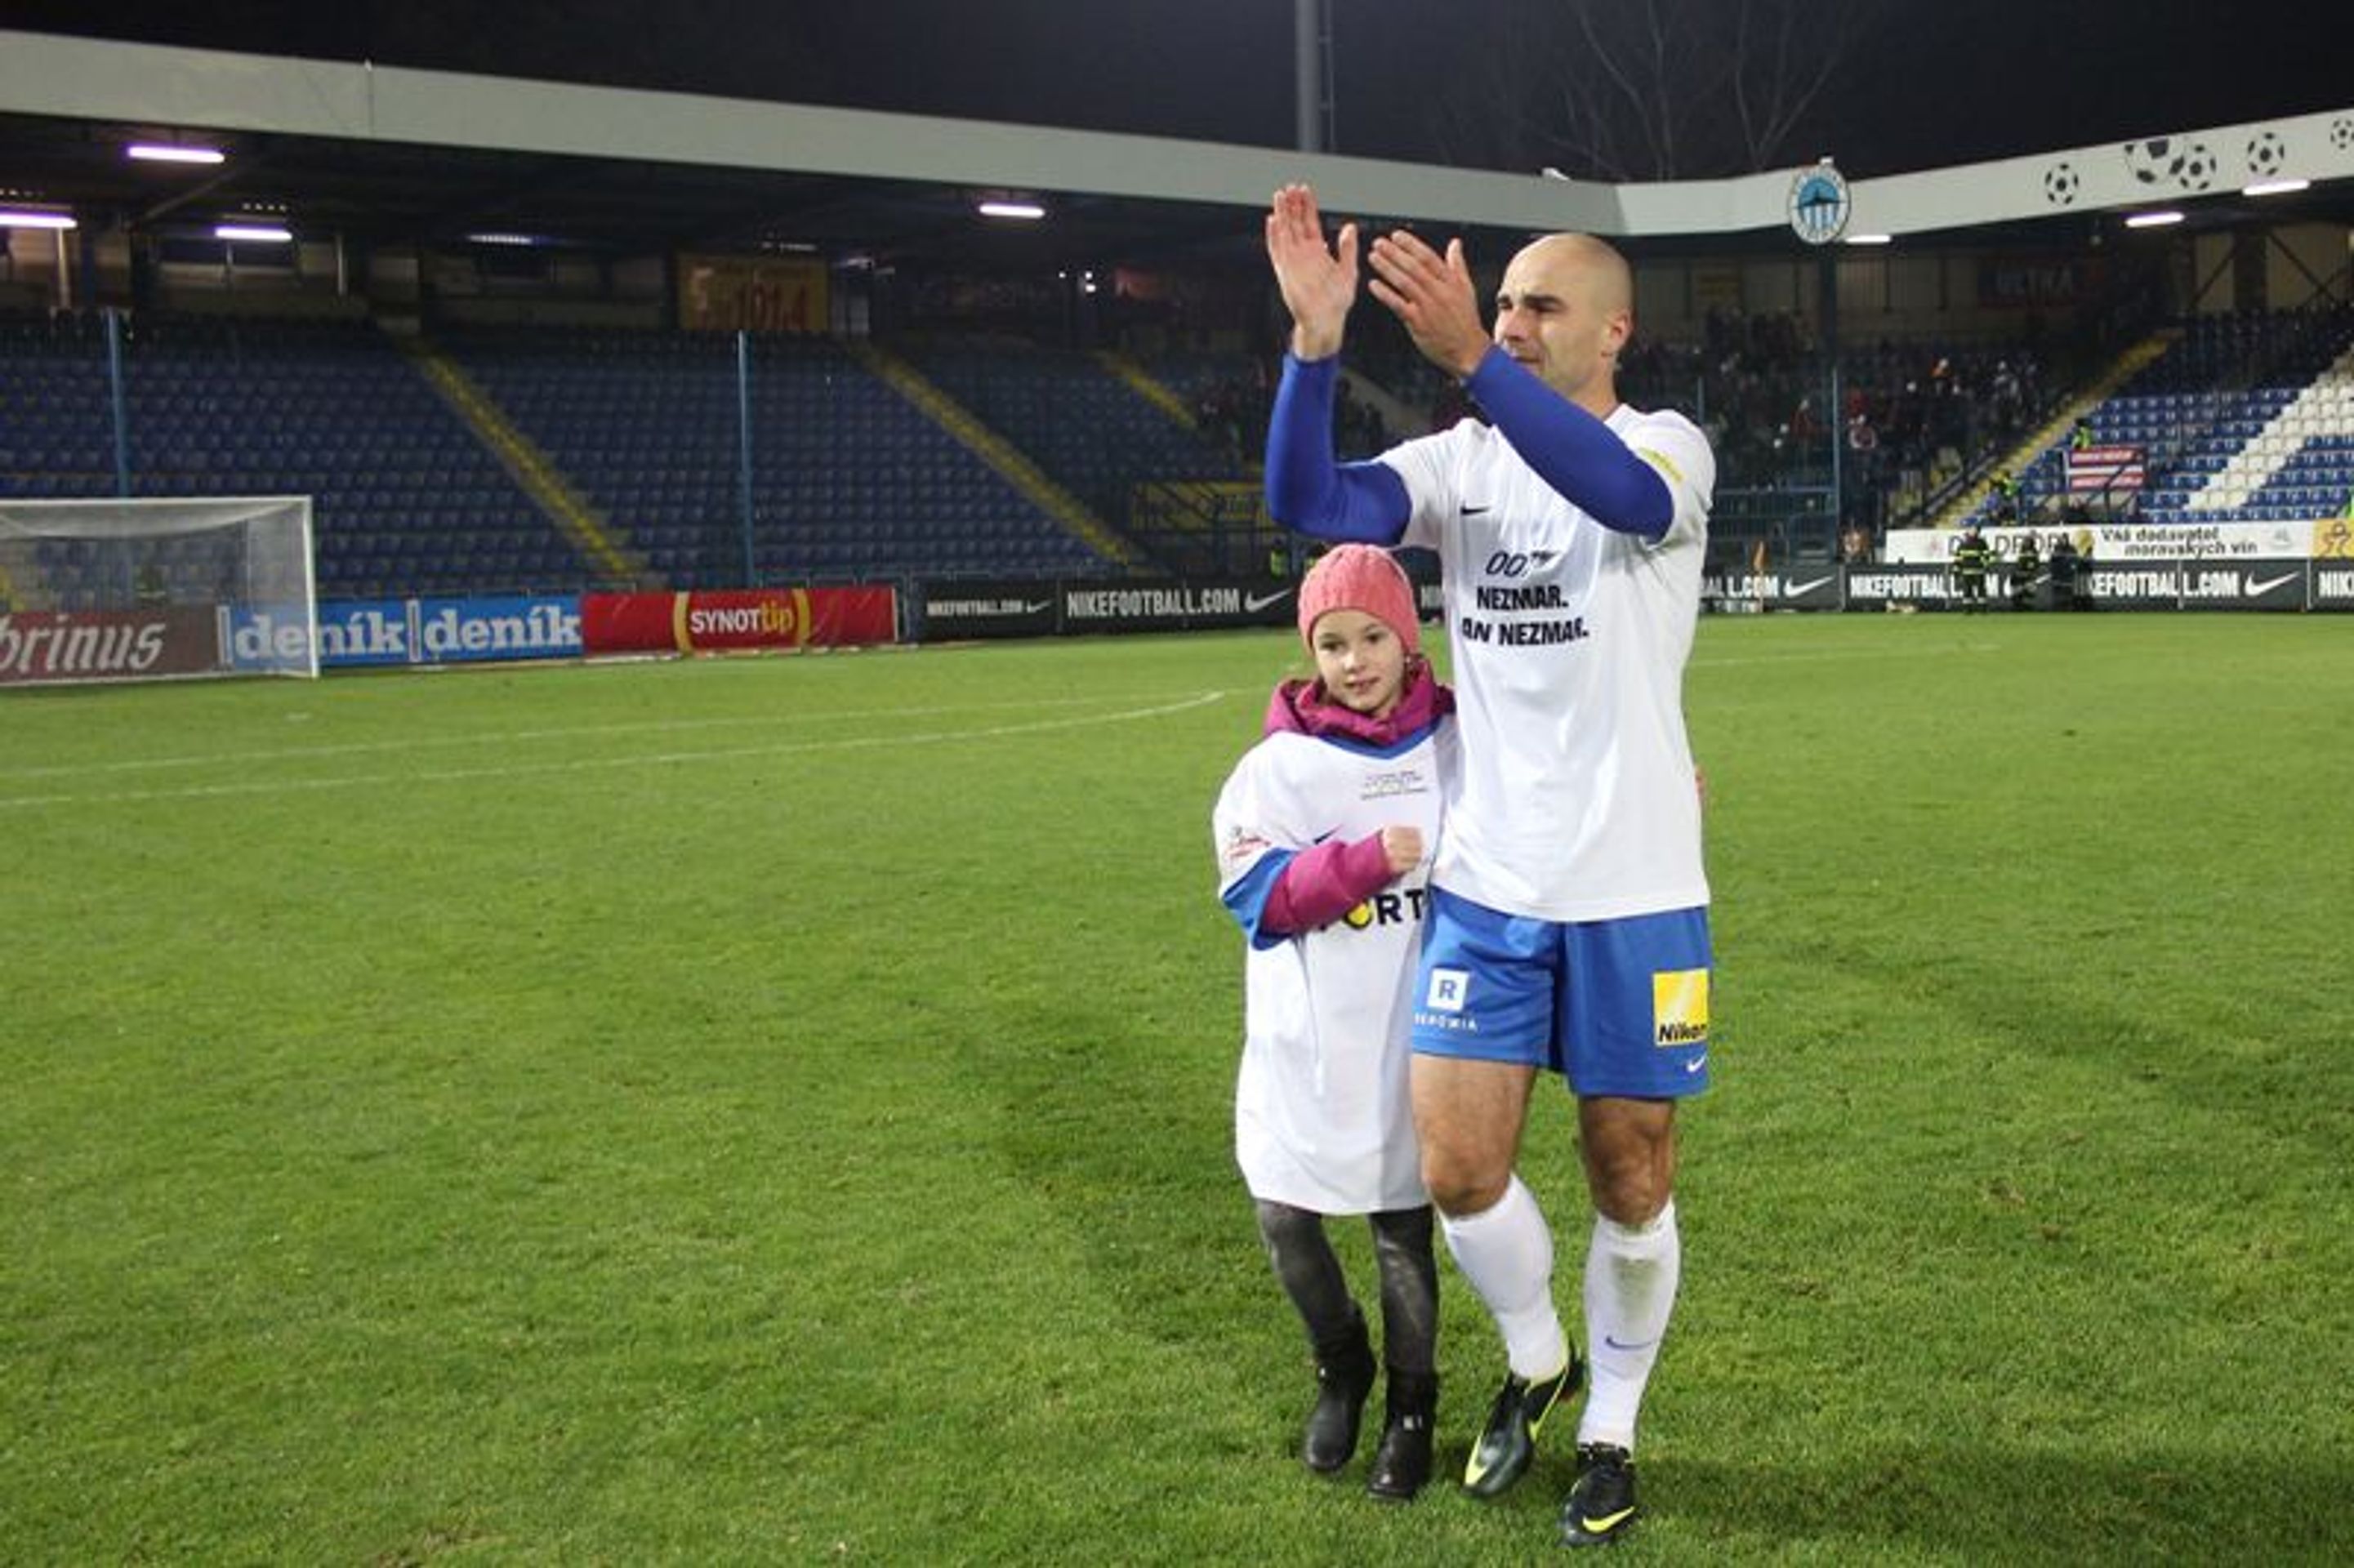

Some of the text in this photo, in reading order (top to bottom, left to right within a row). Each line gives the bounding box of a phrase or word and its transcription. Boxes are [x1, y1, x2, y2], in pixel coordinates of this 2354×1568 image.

[2135, 526, 2219, 542] dodavatel
[1067, 590, 1240, 619] NIKEFOOTBALL.COM
[1477, 585, 1569, 611] NEZMAR.
[234, 611, 405, 659] deník
[424, 600, 582, 653] deník
[1461, 617, 1492, 643] AN
[1342, 889, 1424, 930] ORT
[1438, 978, 1457, 1000] R
